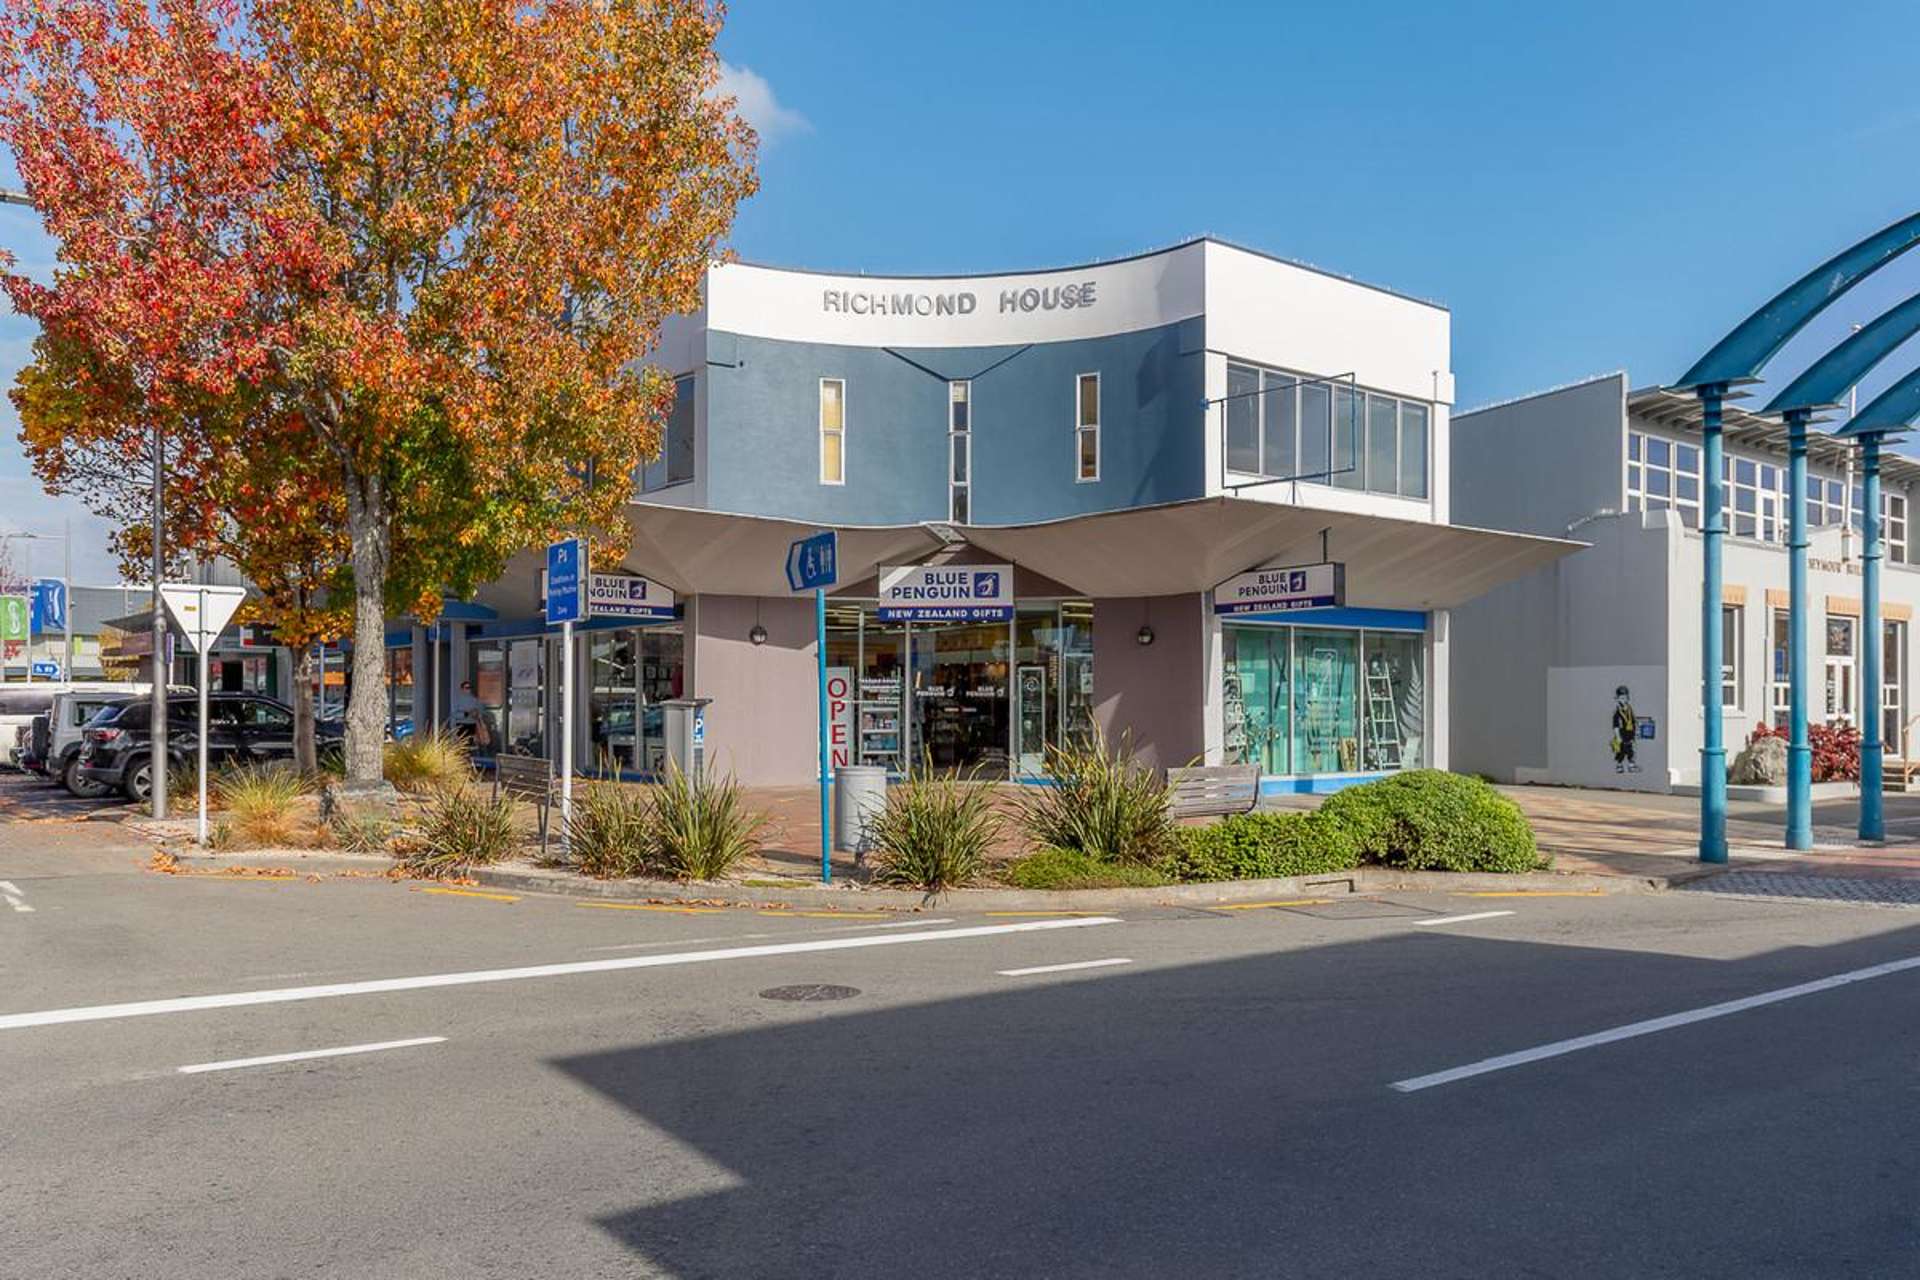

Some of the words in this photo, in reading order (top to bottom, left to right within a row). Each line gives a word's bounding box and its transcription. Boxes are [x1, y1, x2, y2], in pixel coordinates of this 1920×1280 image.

[823, 289, 977, 316] RICHMOND
[999, 281, 1097, 314] HOUSE
[595, 577, 626, 588] BLUE
[925, 572, 968, 585] BLUE
[1258, 573, 1286, 584] BLUE
[590, 588, 627, 599] NGUIN
[891, 586, 970, 599] PENGUIN
[1238, 583, 1288, 596] PENGUIN
[629, 607, 652, 615] GIFTS
[1233, 604, 1251, 613] NEW
[1253, 601, 1288, 611] ZEALAND
[1290, 599, 1312, 608] GIFTS
[887, 609, 913, 618] NEW
[917, 609, 968, 618] ZEALAND
[972, 609, 1004, 618] GIFTS
[827, 678, 848, 769] OPEN
